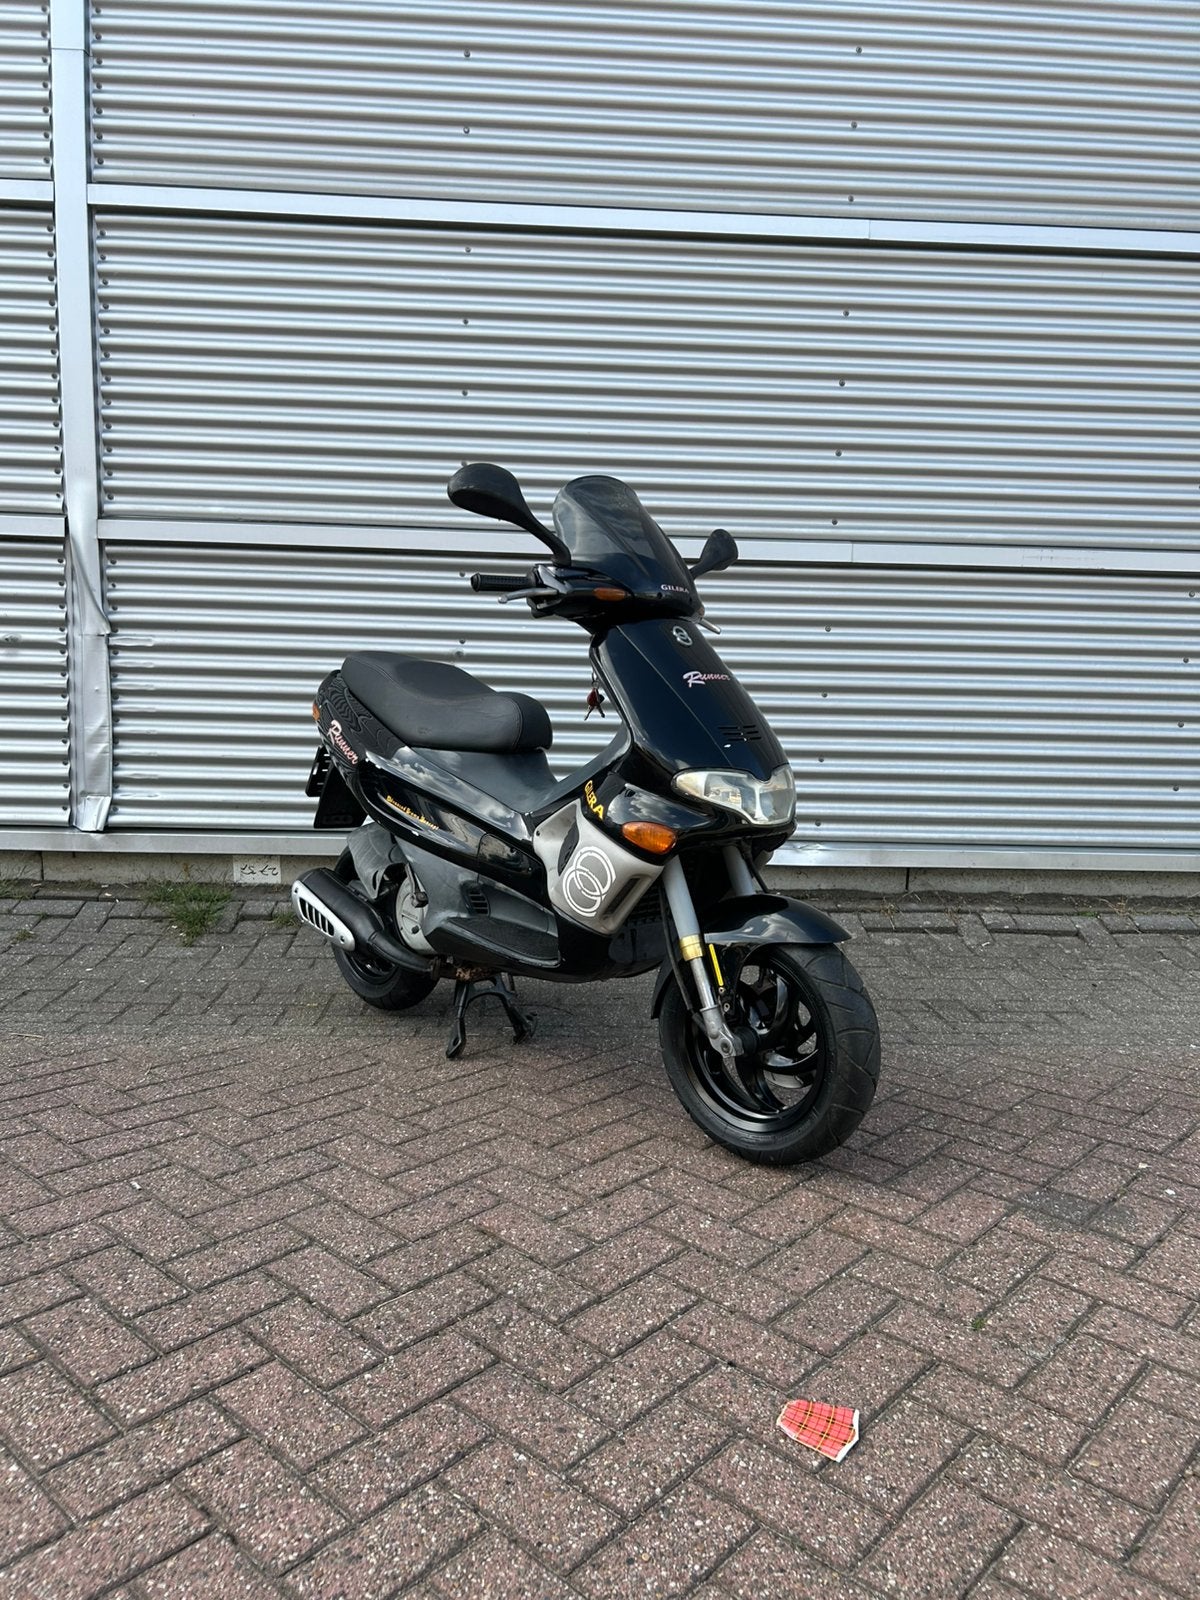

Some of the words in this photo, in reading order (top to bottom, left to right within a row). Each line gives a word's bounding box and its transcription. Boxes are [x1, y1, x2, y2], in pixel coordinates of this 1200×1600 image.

[661, 584, 689, 593] GILERA
[683, 671, 730, 688] Runner
[326, 719, 358, 764] Runner
[585, 780, 603, 819] GILERA
